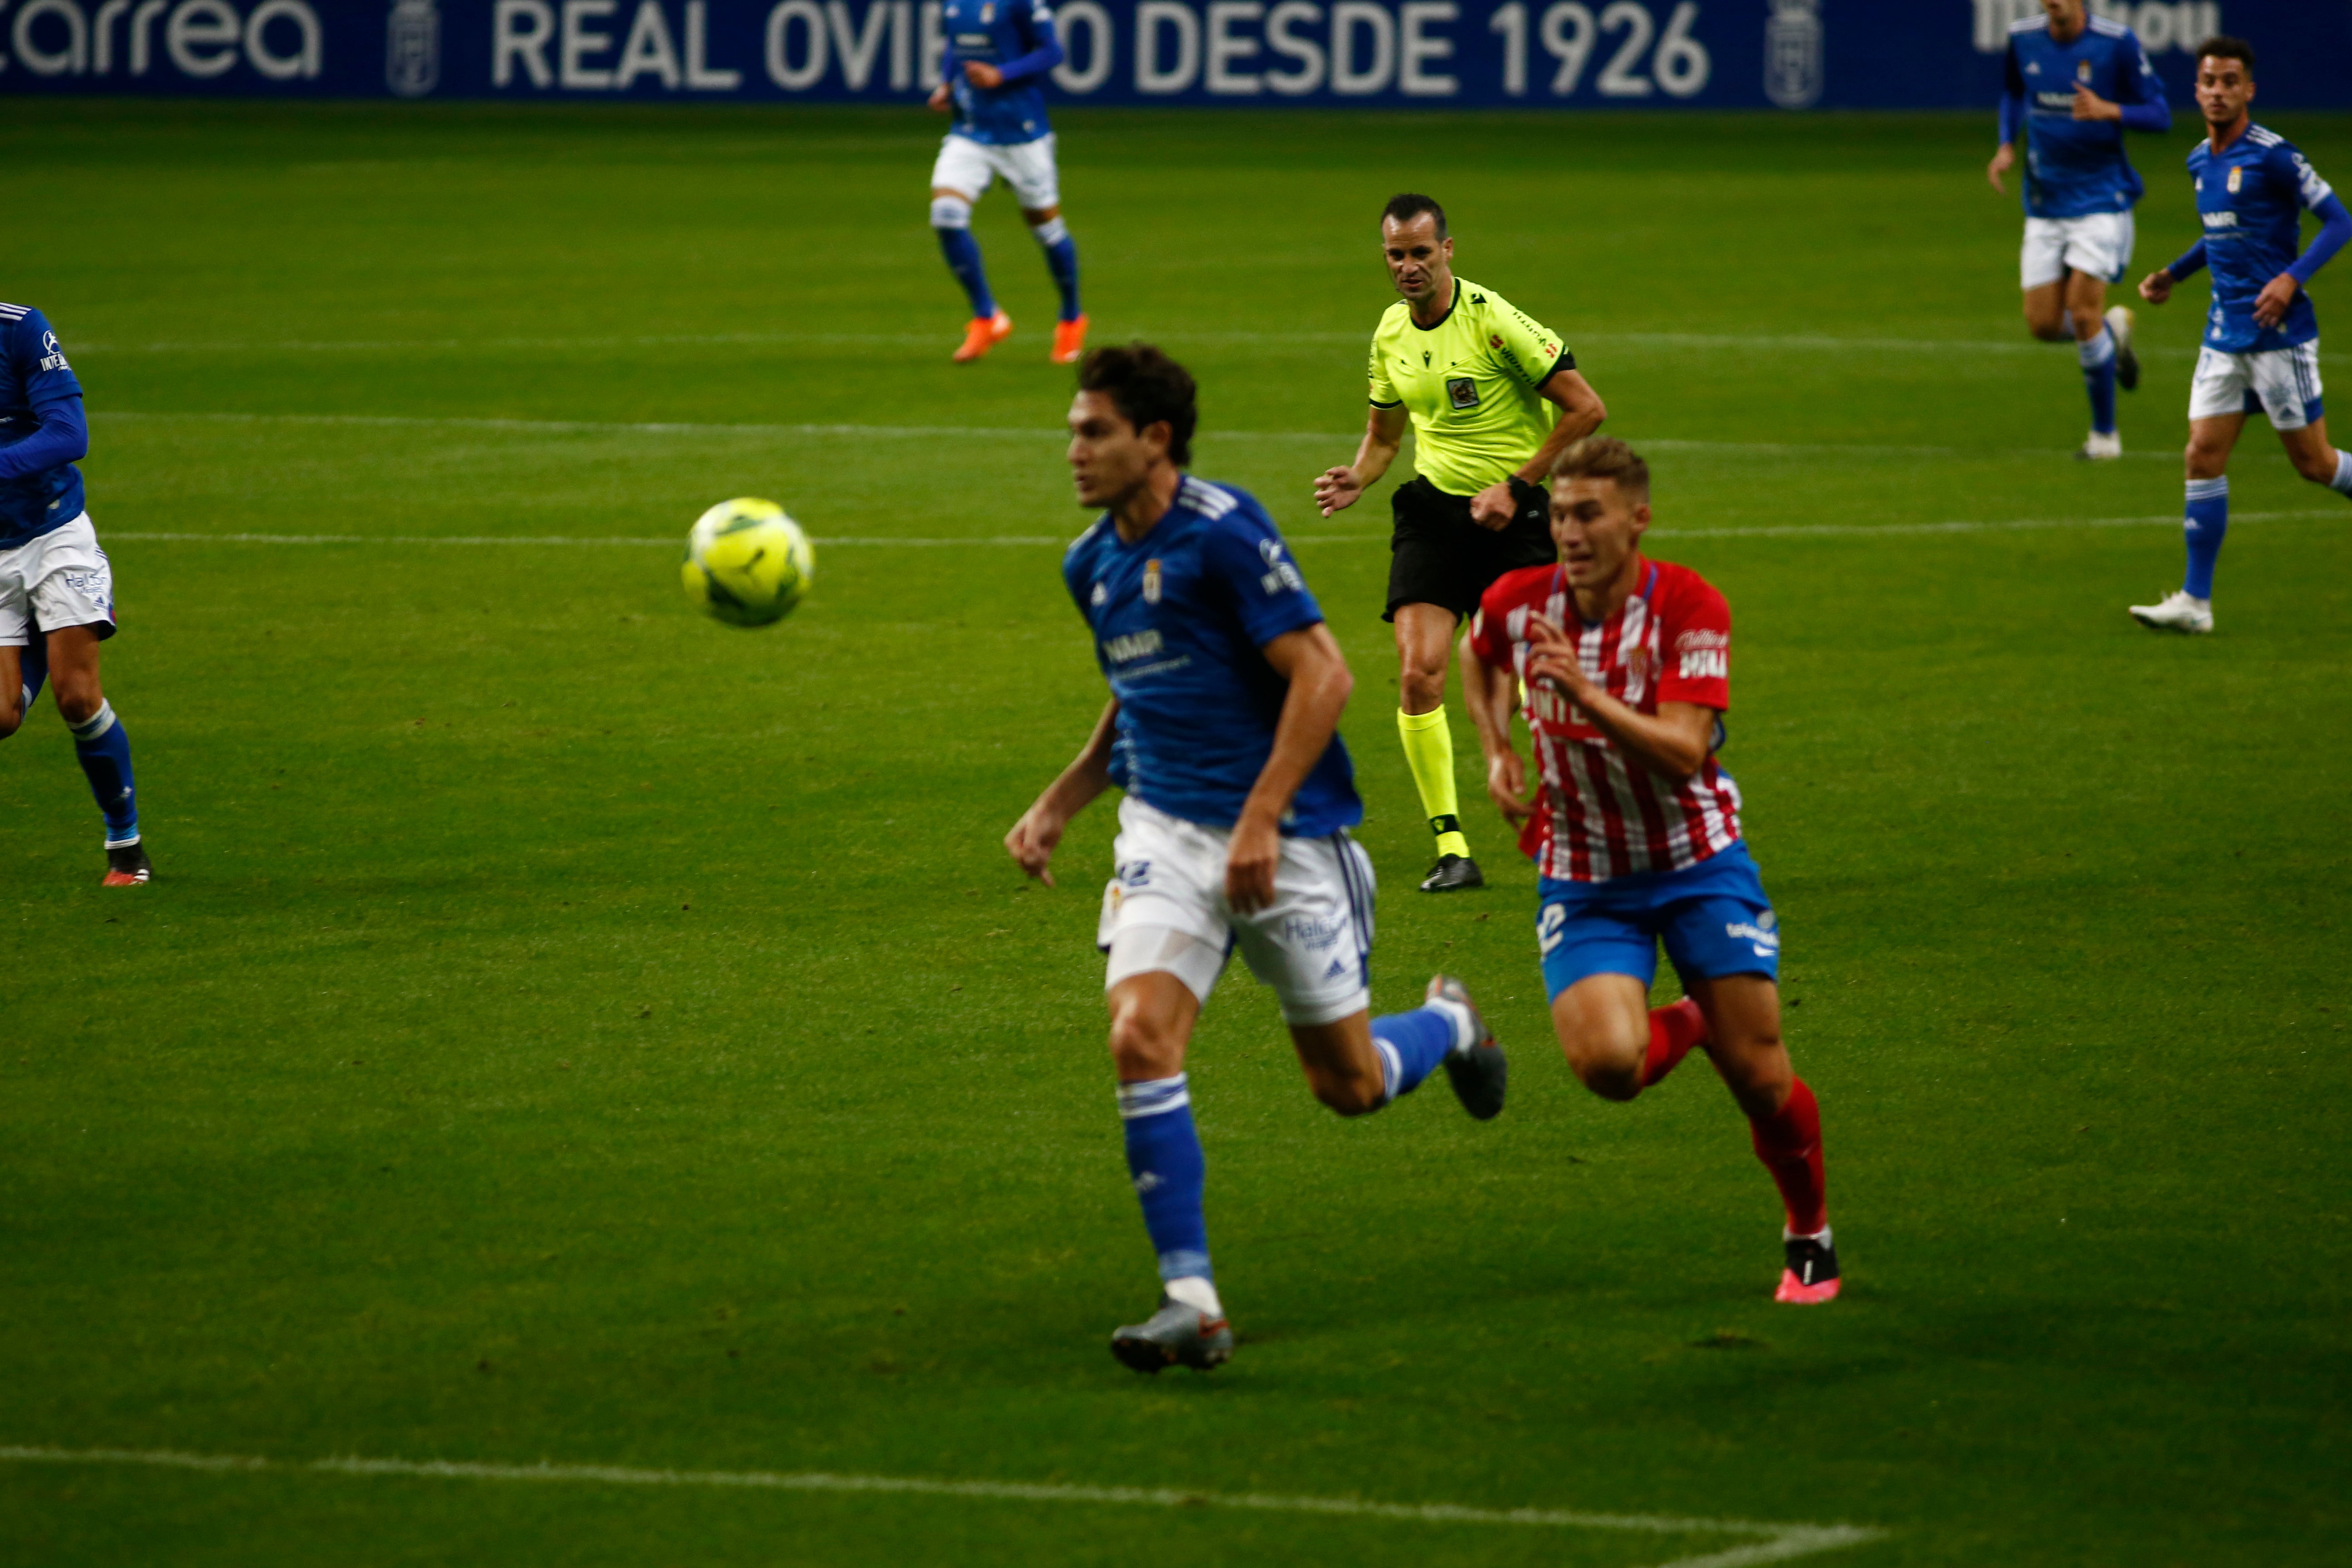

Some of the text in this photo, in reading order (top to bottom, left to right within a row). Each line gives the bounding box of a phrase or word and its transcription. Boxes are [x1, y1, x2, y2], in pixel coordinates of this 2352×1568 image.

[0, 0, 323, 78] arrea
[492, 0, 1711, 94] REAL OVIEO DESDE 1926
